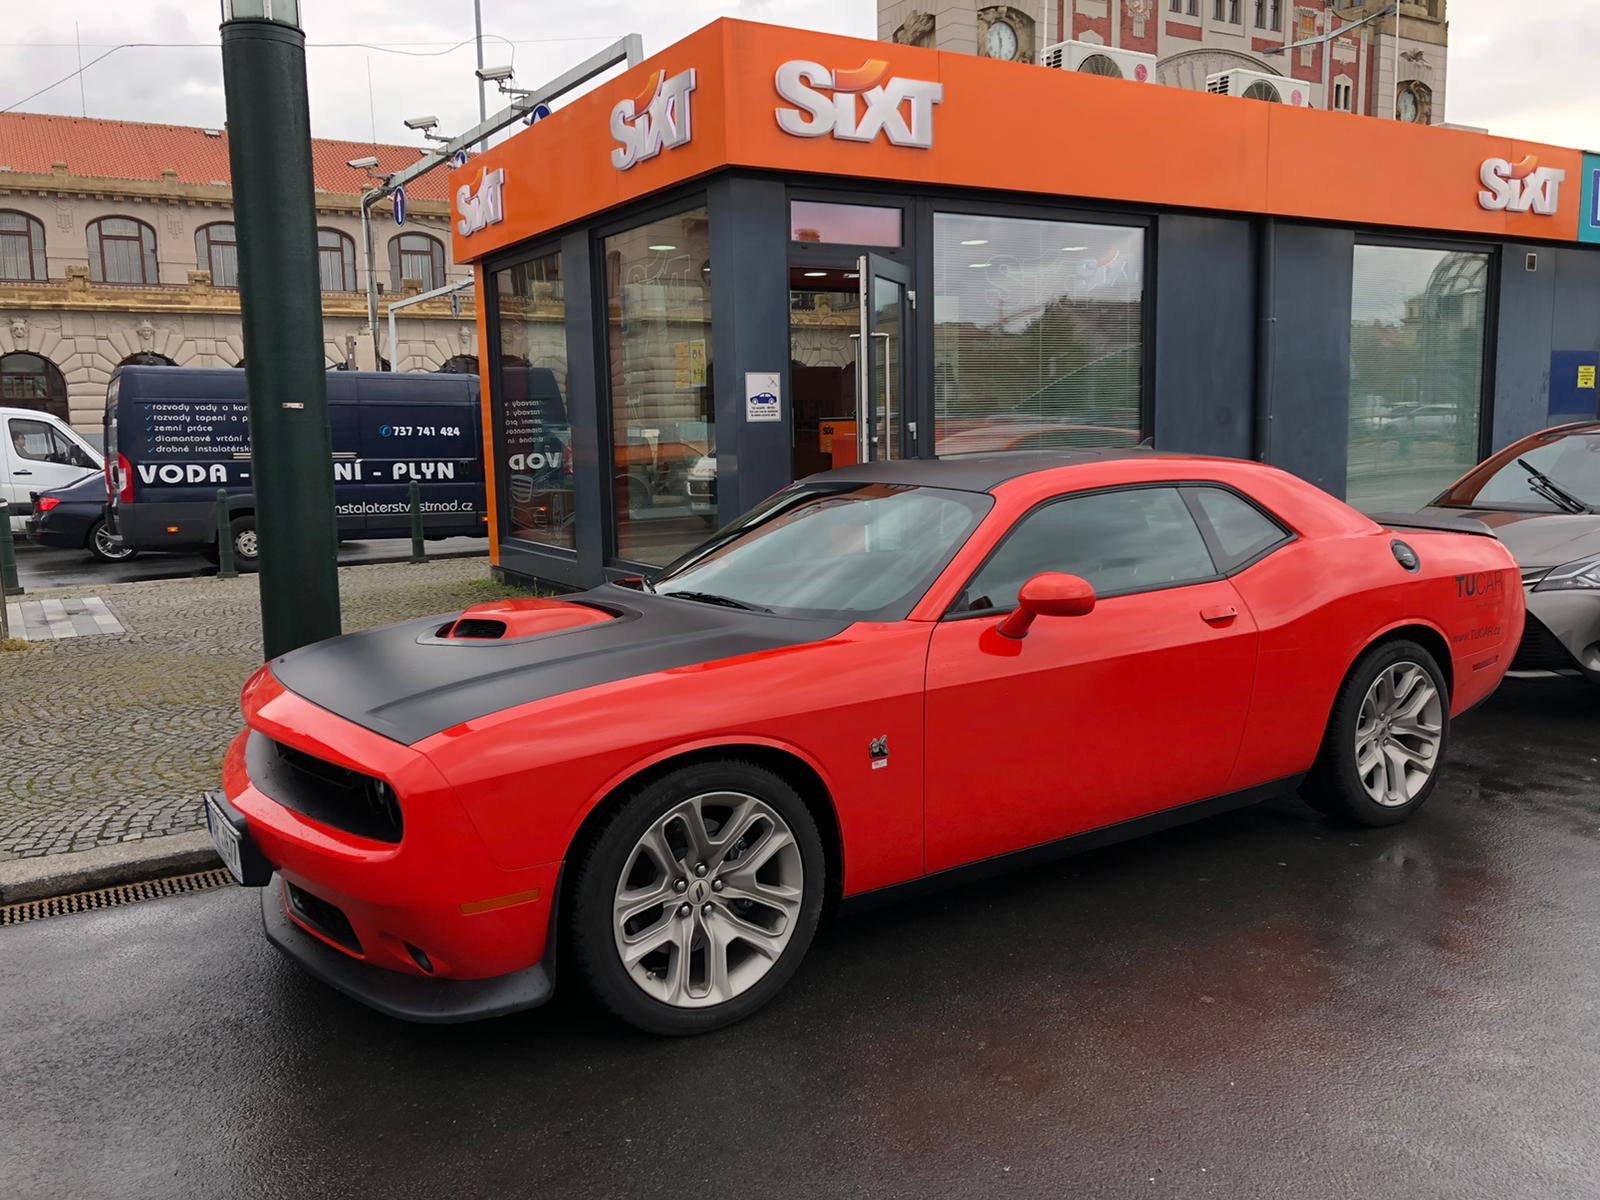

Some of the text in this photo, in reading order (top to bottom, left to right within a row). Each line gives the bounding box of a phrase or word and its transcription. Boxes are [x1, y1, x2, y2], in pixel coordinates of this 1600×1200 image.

[152, 403, 190, 412] rozvody
[195, 403, 218, 412] vody
[153, 414, 191, 423] rozvody
[195, 414, 226, 423] topení
[154, 424, 213, 433] zemní práce
[392, 426, 461, 437] 737 741 424
[155, 435, 211, 443] diamantové
[156, 445, 190, 453] drobné
[137, 464, 228, 484] VODA
[392, 462, 455, 480] PLYN
[1455, 570, 1503, 598] TUCAR
